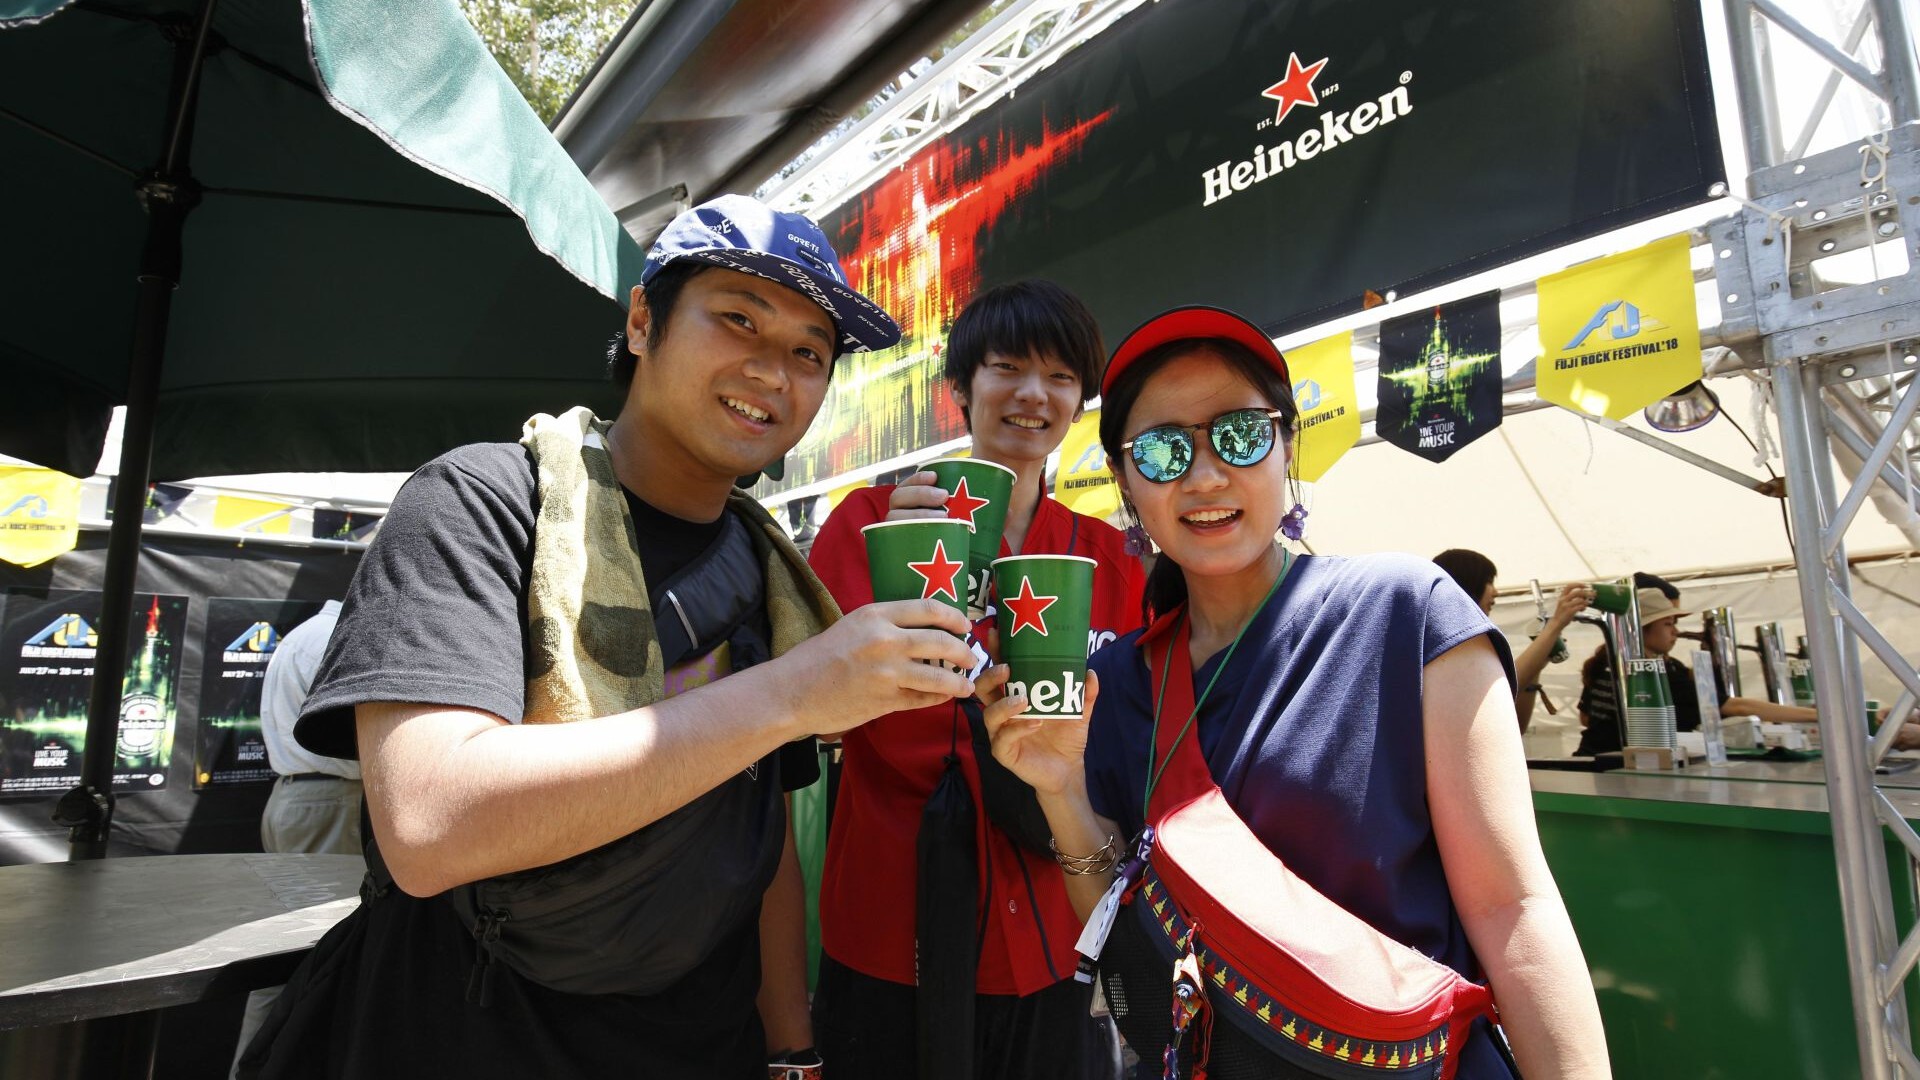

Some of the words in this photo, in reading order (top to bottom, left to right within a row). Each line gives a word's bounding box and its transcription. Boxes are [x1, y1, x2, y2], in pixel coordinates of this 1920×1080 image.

[1257, 117, 1273, 131] EST.
[1321, 83, 1340, 98] 1873
[1202, 85, 1413, 207] Heineken
[1555, 358, 1579, 370] FUJI
[1581, 351, 1611, 366] ROCK
[1418, 432, 1455, 448] MUSIC
[1004, 671, 1085, 713] nek
[33, 756, 69, 768] MUSIC
[237, 752, 265, 761] MUSIC
